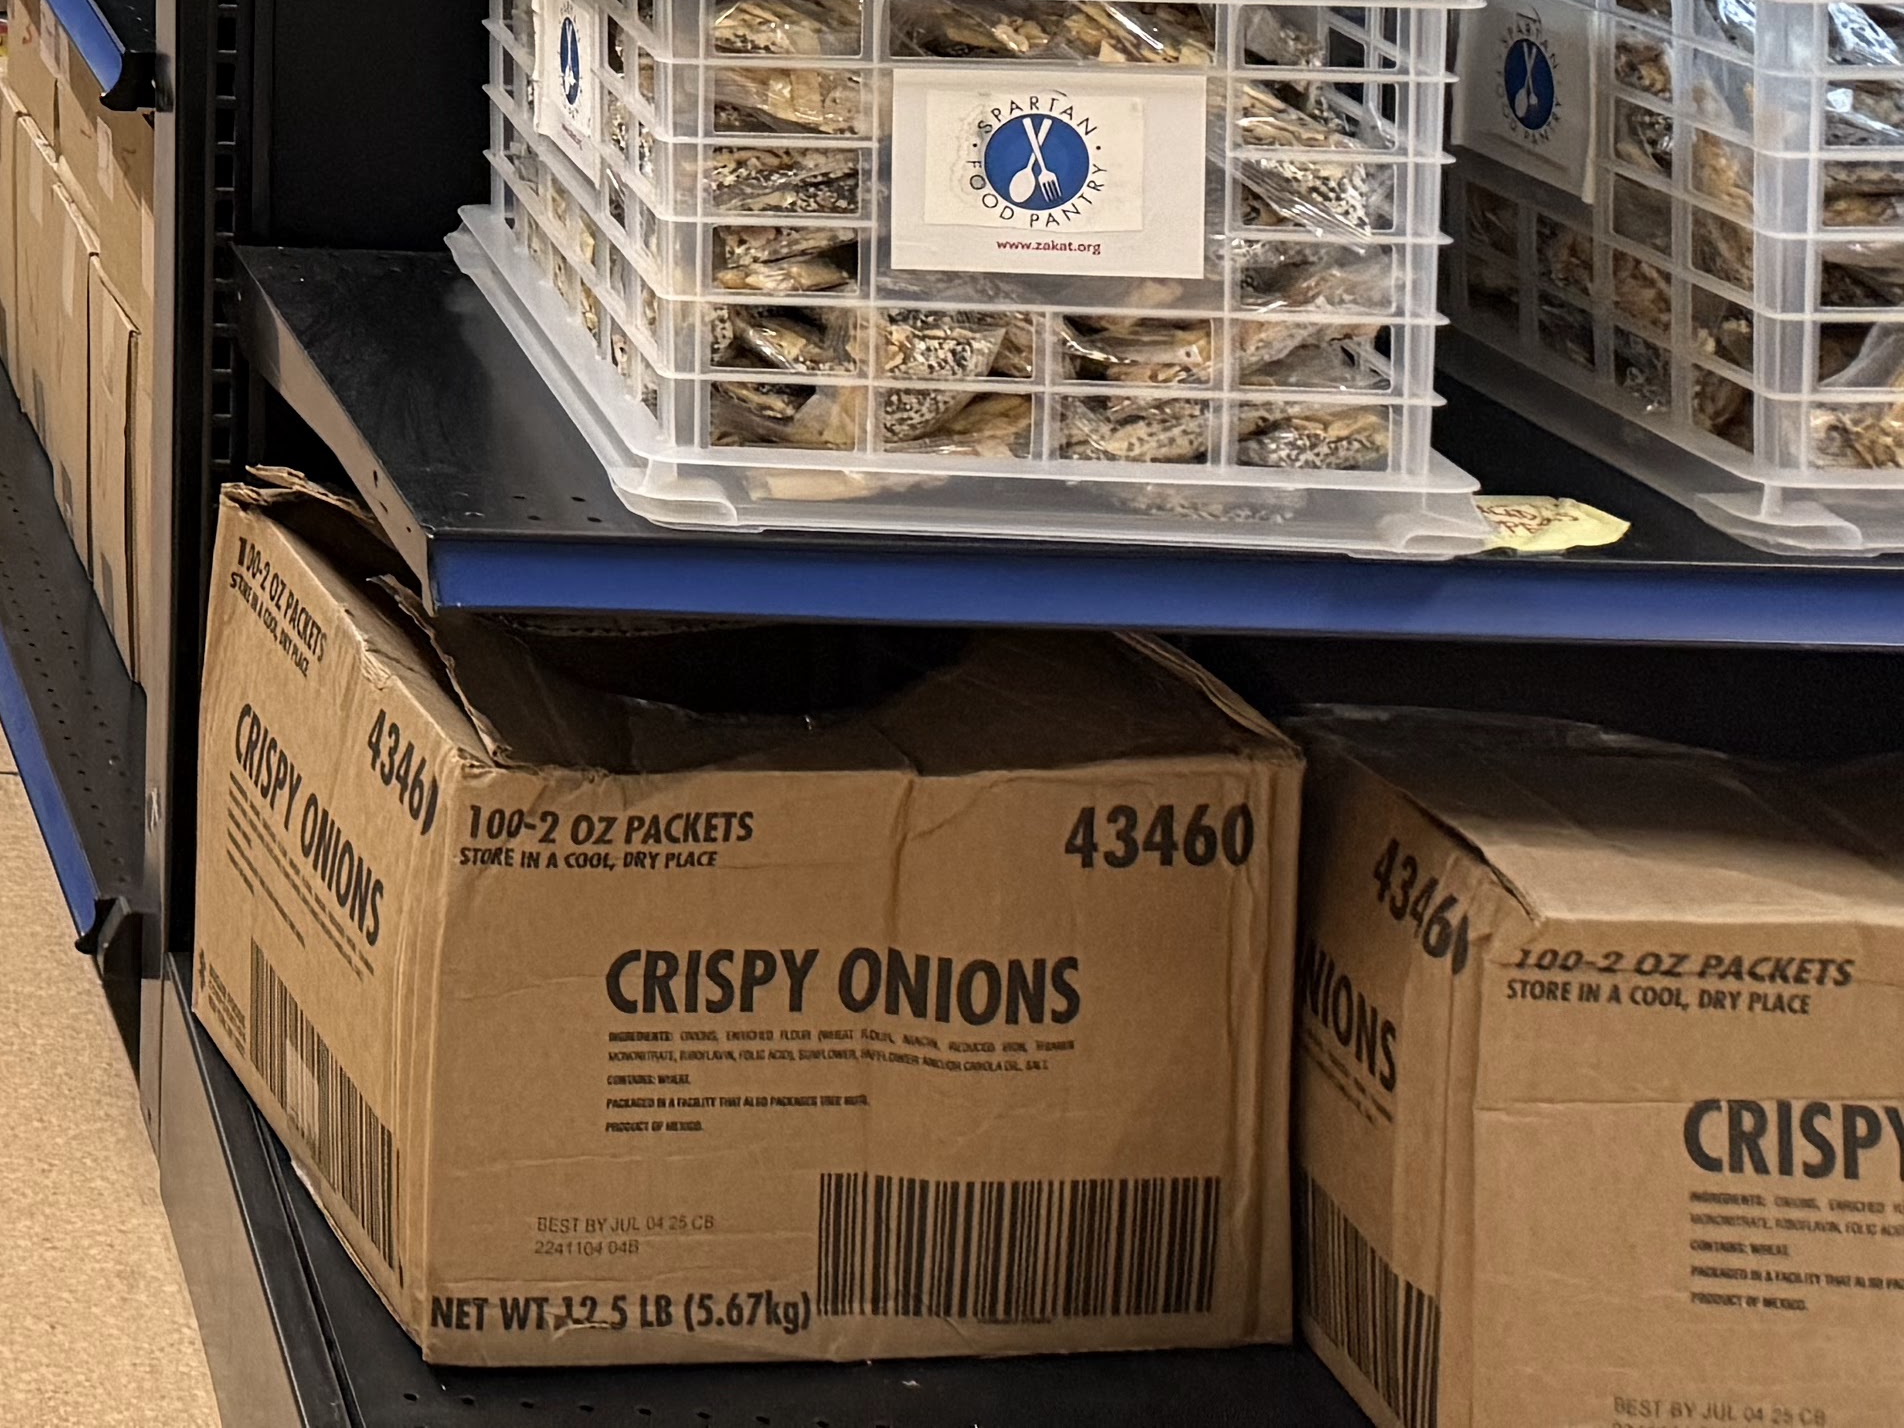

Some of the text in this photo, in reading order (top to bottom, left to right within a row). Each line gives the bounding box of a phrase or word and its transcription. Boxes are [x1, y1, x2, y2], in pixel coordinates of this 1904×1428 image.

[978, 96, 1098, 136] SPARTAN
[966, 160, 1108, 228] FOOD PANTRY
[996, 241, 1101, 255] www.zakat.org
[469, 803, 1254, 869] 100-2 OZ PACKETS 43460
[459, 847, 514, 866] STORE
[521, 851, 540, 868] IN
[546, 852, 558, 868] A
[623, 851, 660, 869] DRY
[665, 851, 718, 868] PLACE
[606, 947, 1081, 1026] CRISPY ONIONS
[537, 1215, 714, 1233] BEST BY JUL 04 25 CB
[431, 1296, 488, 1331] NET
[500, 1297, 549, 1331] WT
[640, 1294, 672, 1329] LB
[684, 1290, 811, 1335] (5.67kg)
